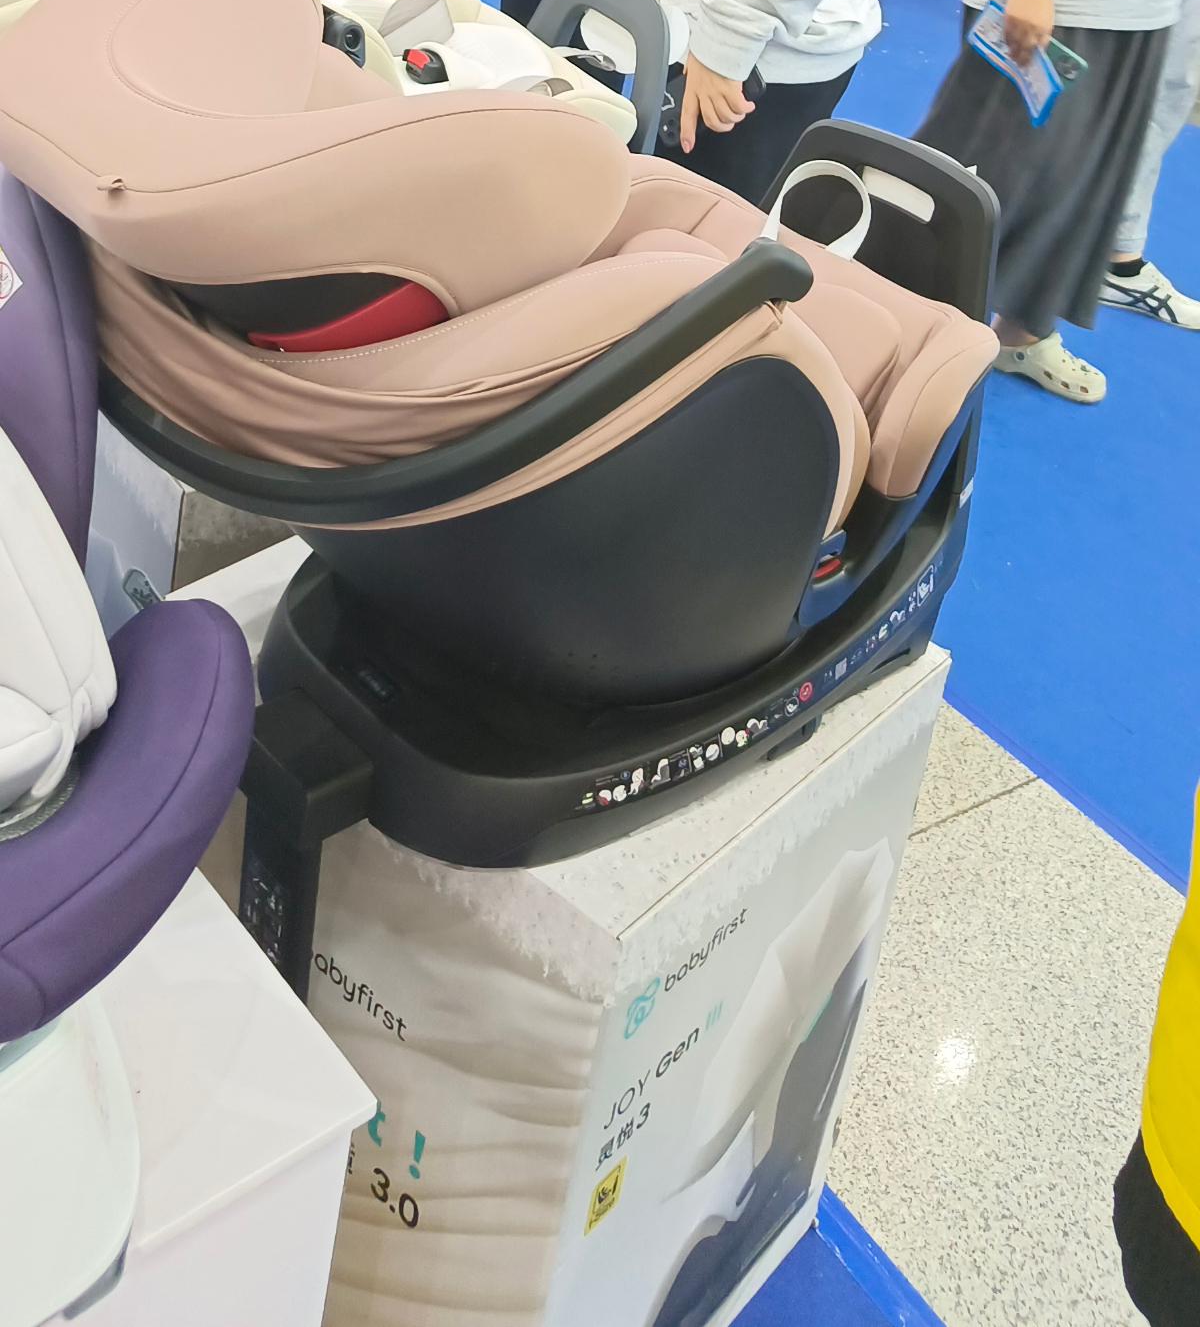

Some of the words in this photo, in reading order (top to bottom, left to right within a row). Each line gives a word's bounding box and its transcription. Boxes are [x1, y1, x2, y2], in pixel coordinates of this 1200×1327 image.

[664, 908, 748, 992] babyfirst
[313, 953, 406, 1042] abyfirst
[603, 1069, 651, 1130] JOY
[655, 1027, 700, 1078] Gen
[370, 1166, 420, 1229] 3.0
